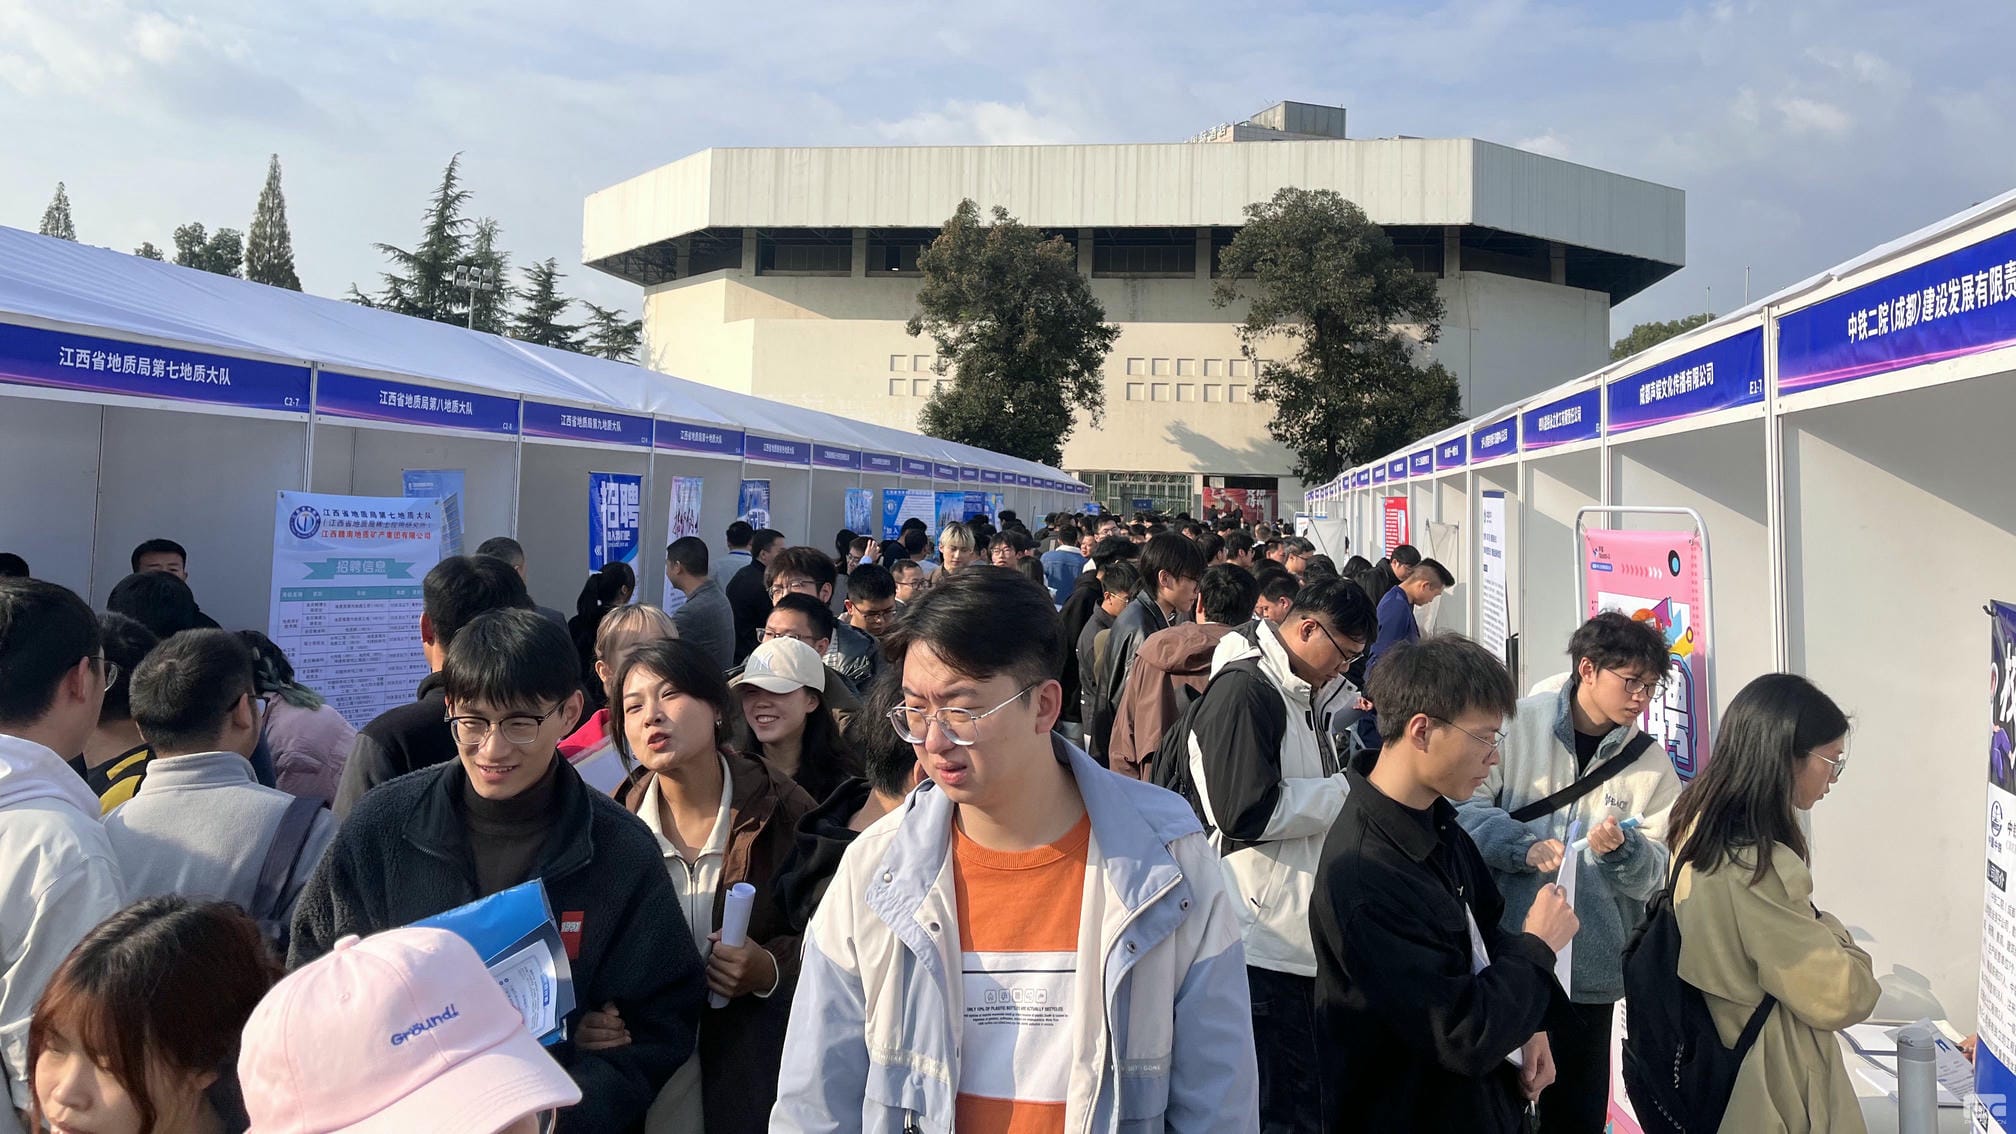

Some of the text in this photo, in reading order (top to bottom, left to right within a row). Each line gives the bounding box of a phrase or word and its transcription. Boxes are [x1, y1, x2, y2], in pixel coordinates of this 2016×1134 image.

[59, 346, 231, 386] 江西省地质局第七地质大队
[1749, 378, 1763, 395] E1-7
[284, 396, 300, 407] C2-7
[379, 390, 473, 415] 江西省地质局第八地质大队
[560, 414, 622, 432] 江西省地质局第九地质大队
[600, 480, 639, 528] 招聘
[322, 508, 432, 520] 江西省地质局第七地质大队
[336, 560, 387, 574] 招聘信息
